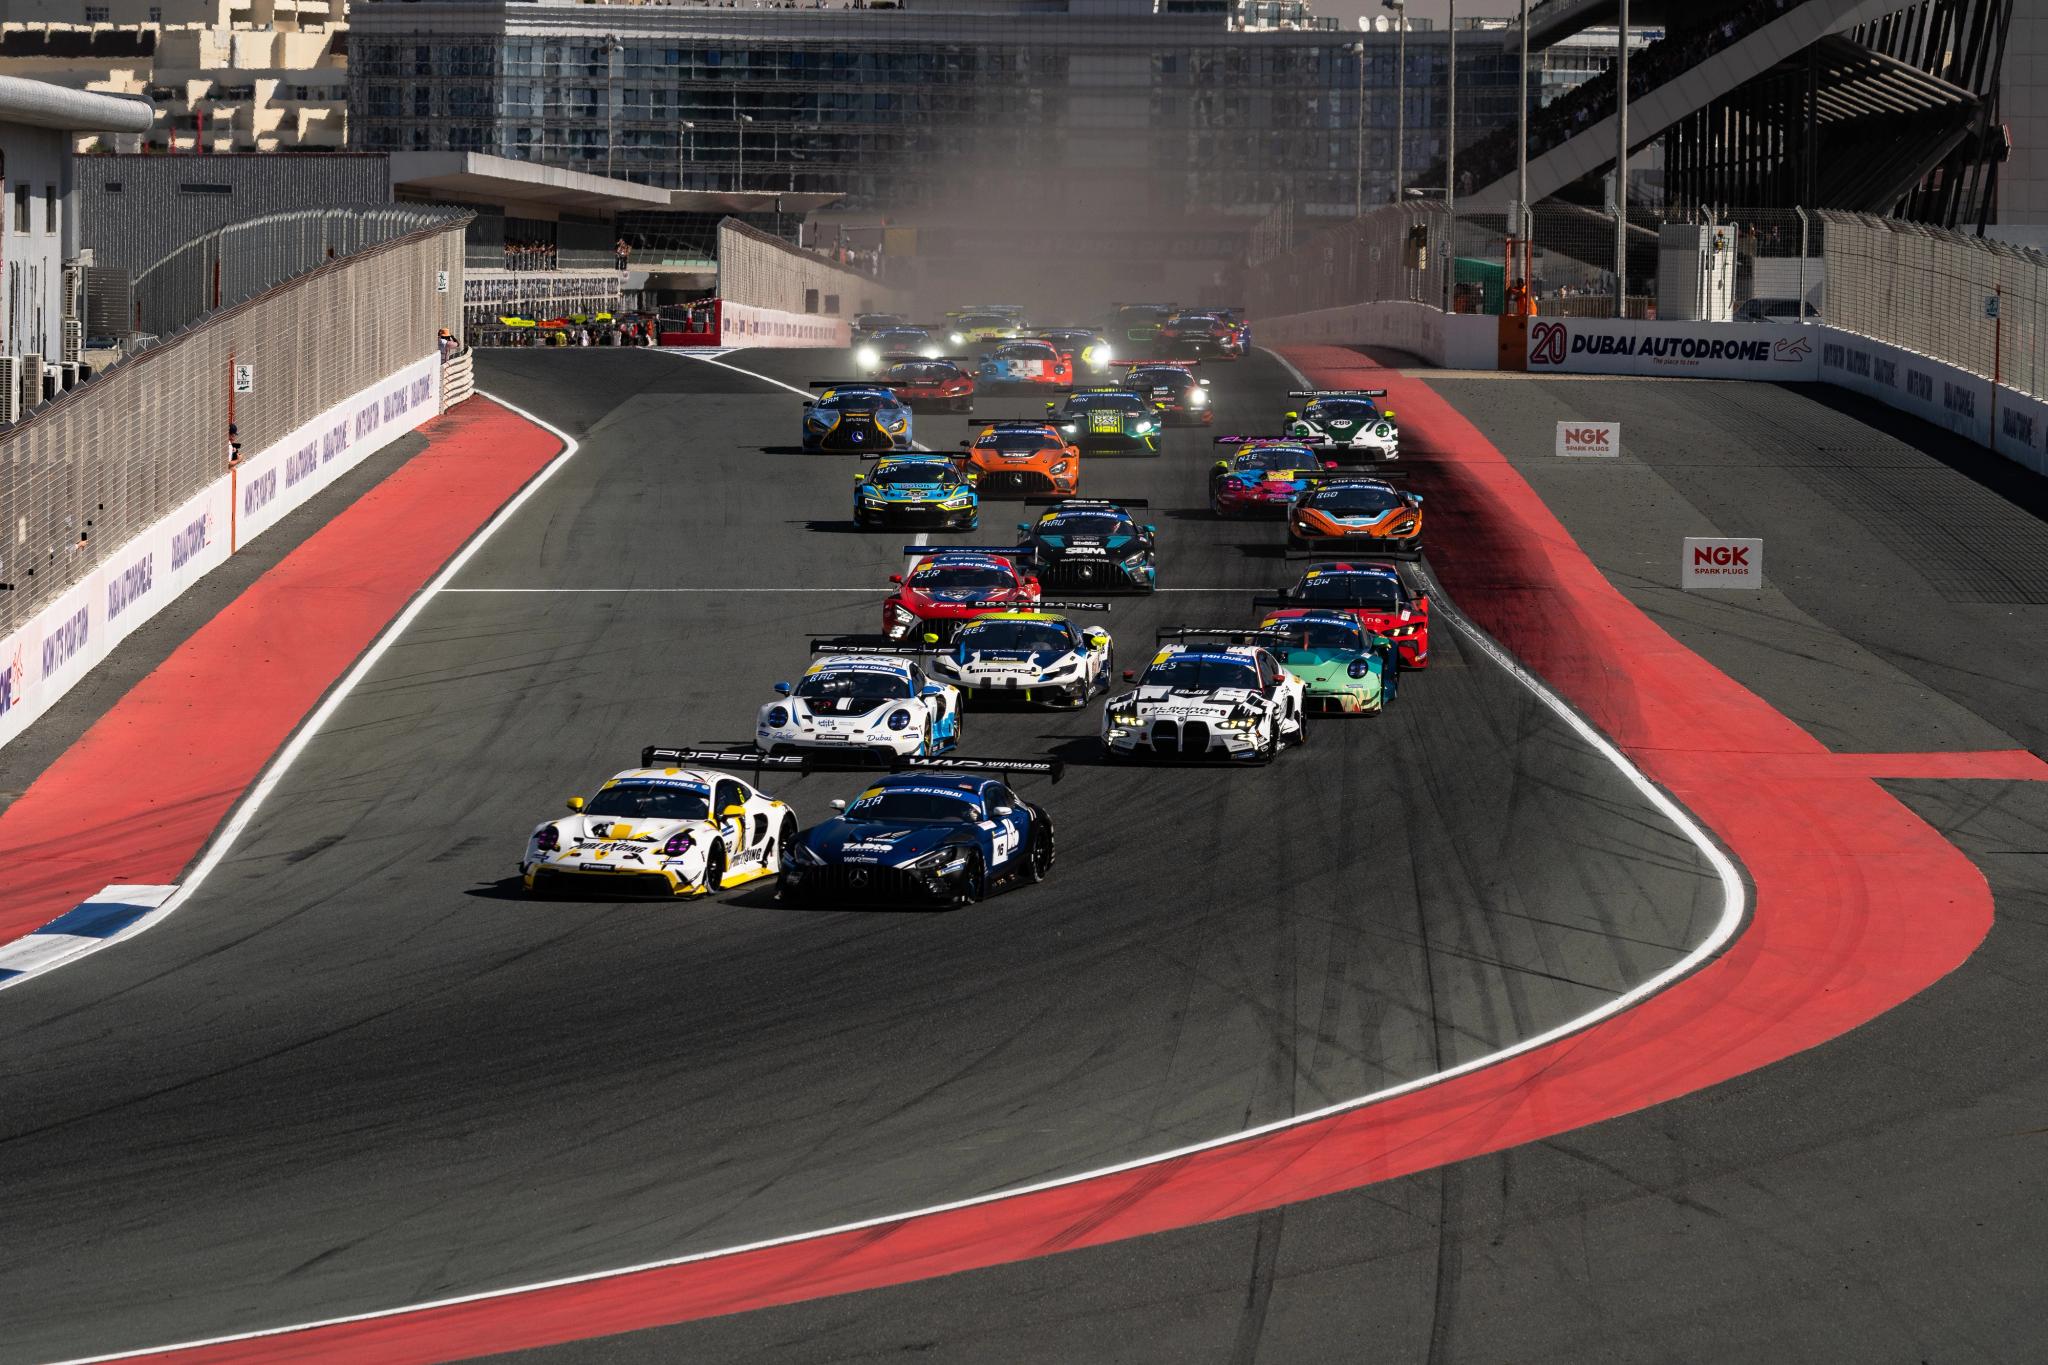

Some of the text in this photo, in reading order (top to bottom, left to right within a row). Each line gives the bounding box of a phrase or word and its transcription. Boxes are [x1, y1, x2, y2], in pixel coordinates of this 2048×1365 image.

[1530, 322, 1567, 364] 20
[1571, 334, 1770, 361] DUBAI AUTODROME
[1565, 428, 1610, 445] NGK
[1694, 546, 1750, 566] NGK
[817, 645, 957, 654] PORSCHE
[1221, 655, 1251, 664] DUBAI
[870, 665, 897, 673] DUBAI
[866, 734, 893, 742] Dubai
[652, 749, 805, 763] PORSCHE
[987, 760, 1052, 769] WINWARD
[667, 780, 698, 789] DUBAI
[932, 788, 963, 798] DUBAI
[853, 795, 884, 810] PIA
[997, 843, 1004, 856] 16
